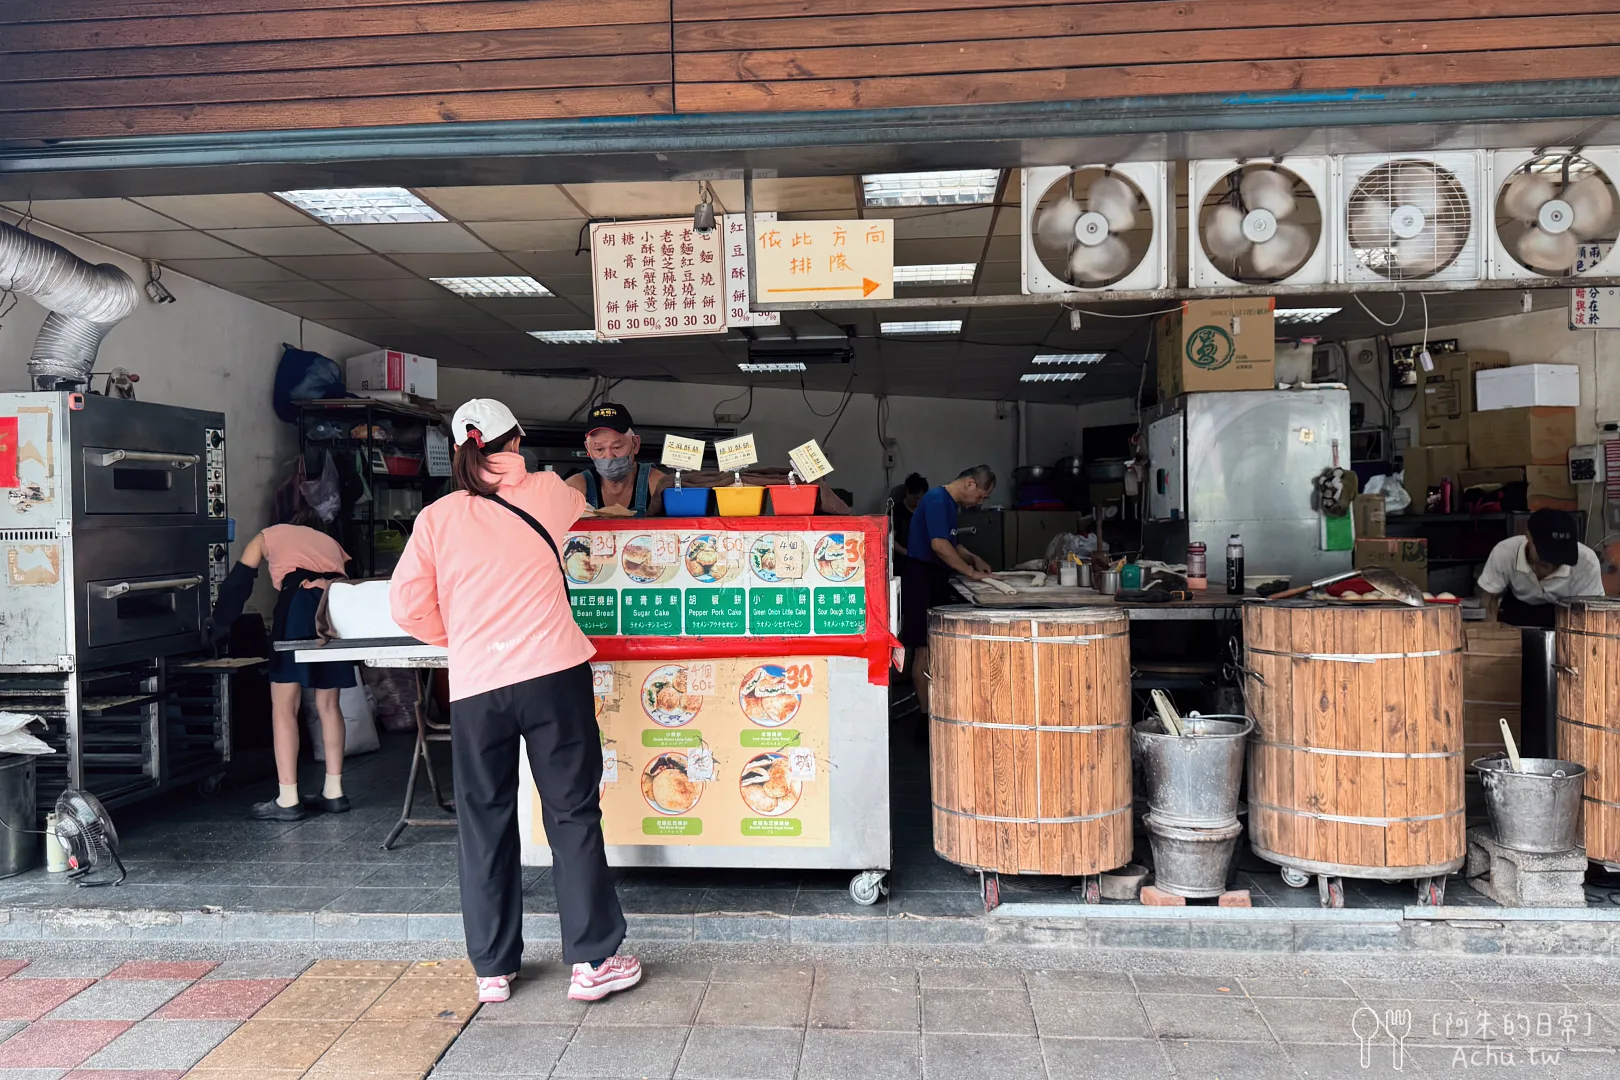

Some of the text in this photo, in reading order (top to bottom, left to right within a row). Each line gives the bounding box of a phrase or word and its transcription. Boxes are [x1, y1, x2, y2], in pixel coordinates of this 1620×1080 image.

[759, 225, 884, 249] 依此方向
[680, 228, 697, 326] 老麵紅豆燒餅 30
[730, 222, 746, 302] 紅豆酥餅
[790, 252, 853, 274] 排隊
[602, 234, 620, 330] 胡椒餅 60
[622, 232, 640, 329] 糖膏酥餅 30
[660, 230, 678, 327] 老麵芝麻燒餅 30
[703, 314, 716, 324] 30
[1588, 288, 1600, 324] 分在於
[818, 594, 865, 604] 老麵燒
[830, 608, 843, 616] Dough
[845, 608, 857, 616] Salty
[786, 664, 813, 690] 30
